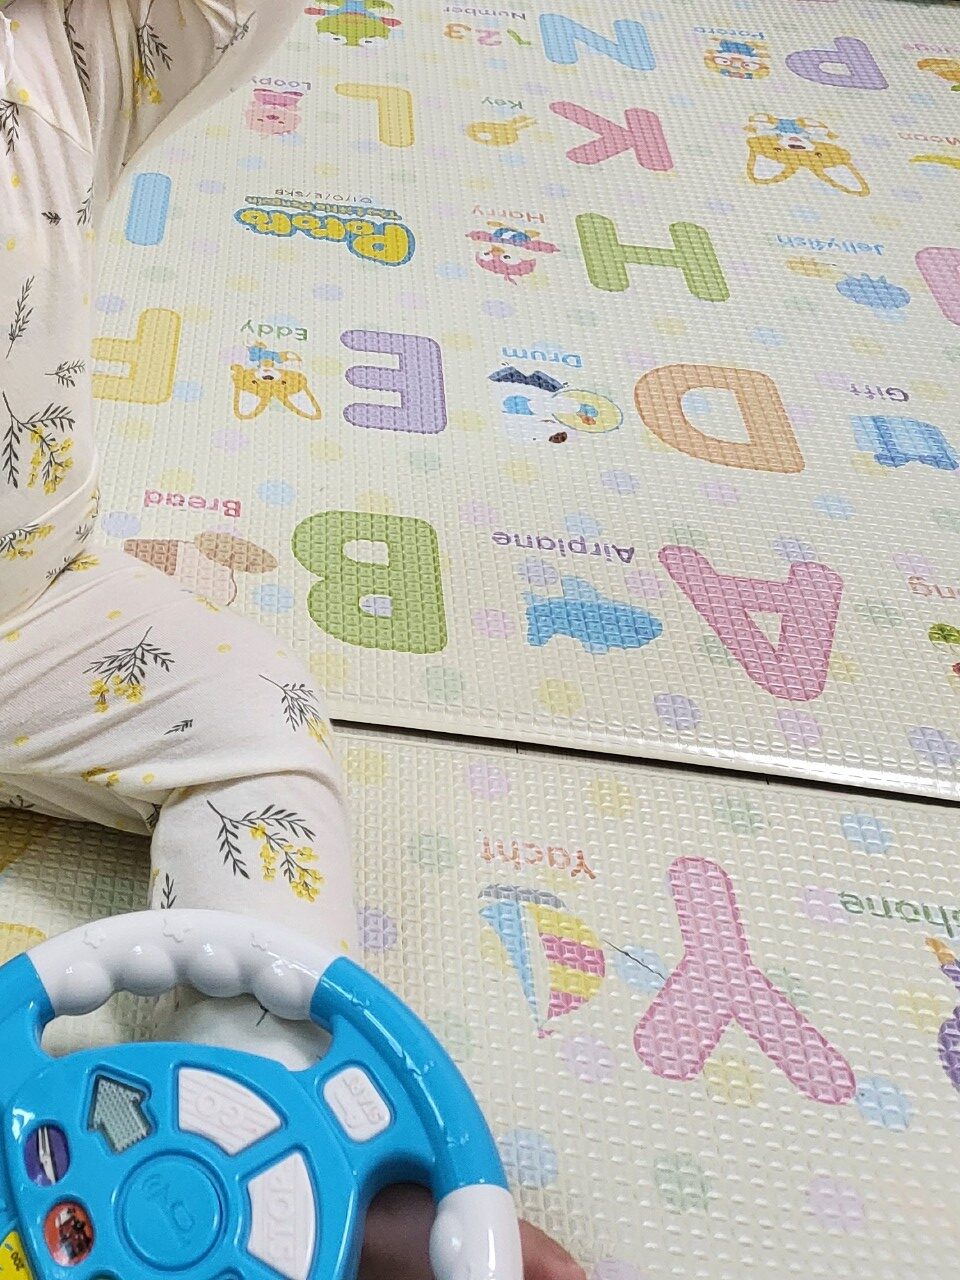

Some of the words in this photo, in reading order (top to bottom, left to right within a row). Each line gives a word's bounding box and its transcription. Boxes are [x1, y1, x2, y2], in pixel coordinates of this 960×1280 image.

[442, 5, 527, 21] Number
[539, 13, 656, 71] N
[784, 37, 890, 90] P
[335, 82, 414, 148] L
[548, 100, 675, 172] K
[233, 207, 416, 267] Pororo
[471, 204, 546, 224] Harry
[574, 212, 731, 303] H
[776, 233, 884, 256] Jellyfish
[240, 319, 308, 342] Eddy
[501, 346, 583, 369] Drum
[339, 328, 447, 435] E
[849, 382, 910, 402] Gift
[633, 363, 806, 474] D
[143, 489, 240, 518] Bread
[491, 531, 636, 564] Airplane
[290, 509, 448, 655] B
[657, 544, 844, 702] A
[481, 835, 596, 880] Yacht
[633, 855, 857, 1105] Y
